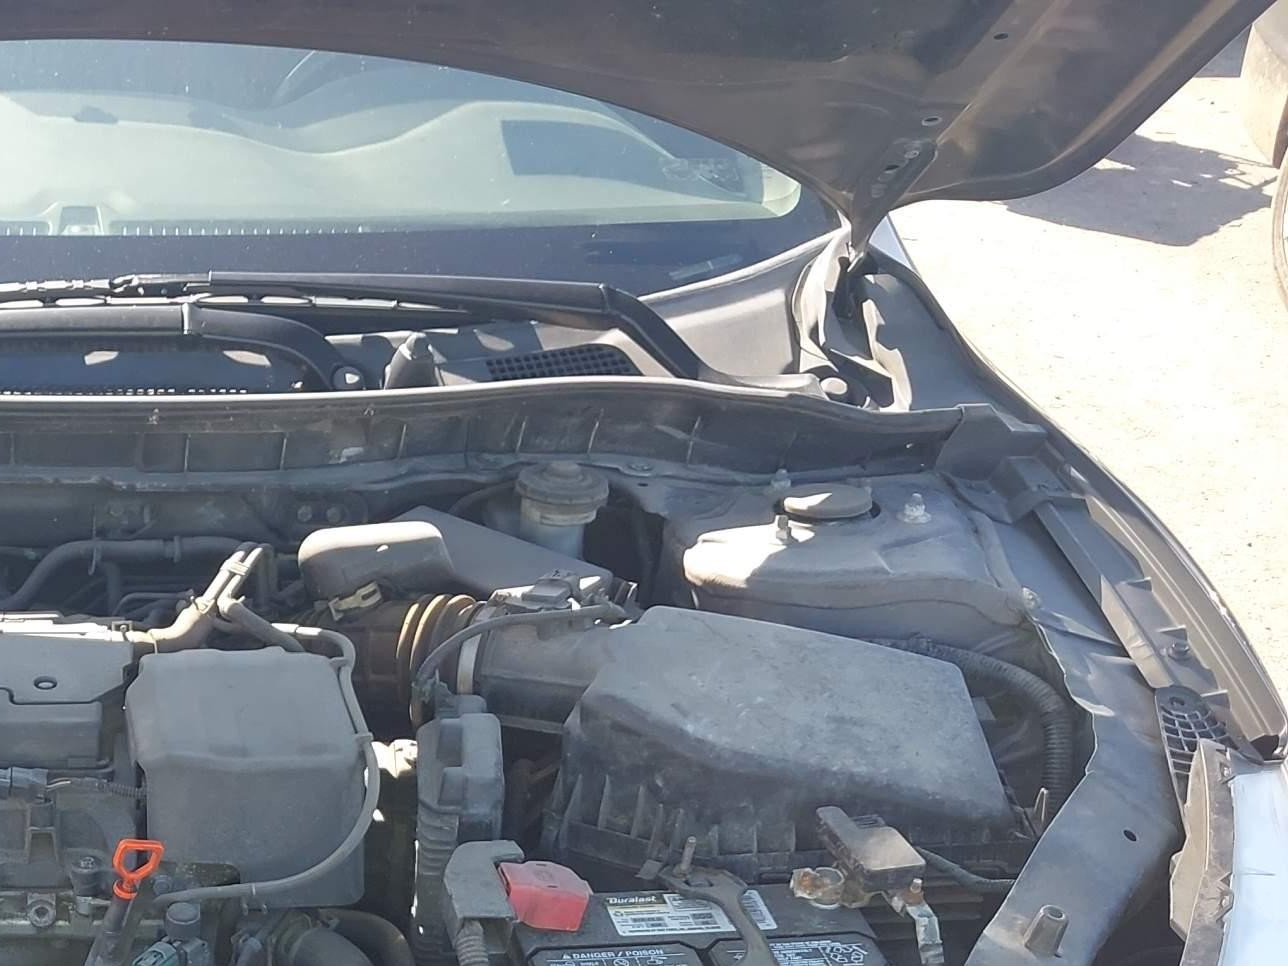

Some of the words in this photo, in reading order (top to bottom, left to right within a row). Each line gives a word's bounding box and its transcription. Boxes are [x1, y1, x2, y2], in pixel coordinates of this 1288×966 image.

[607, 895, 657, 904] Duralast
[572, 951, 614, 959] DANGER
[625, 949, 664, 957] POISON
